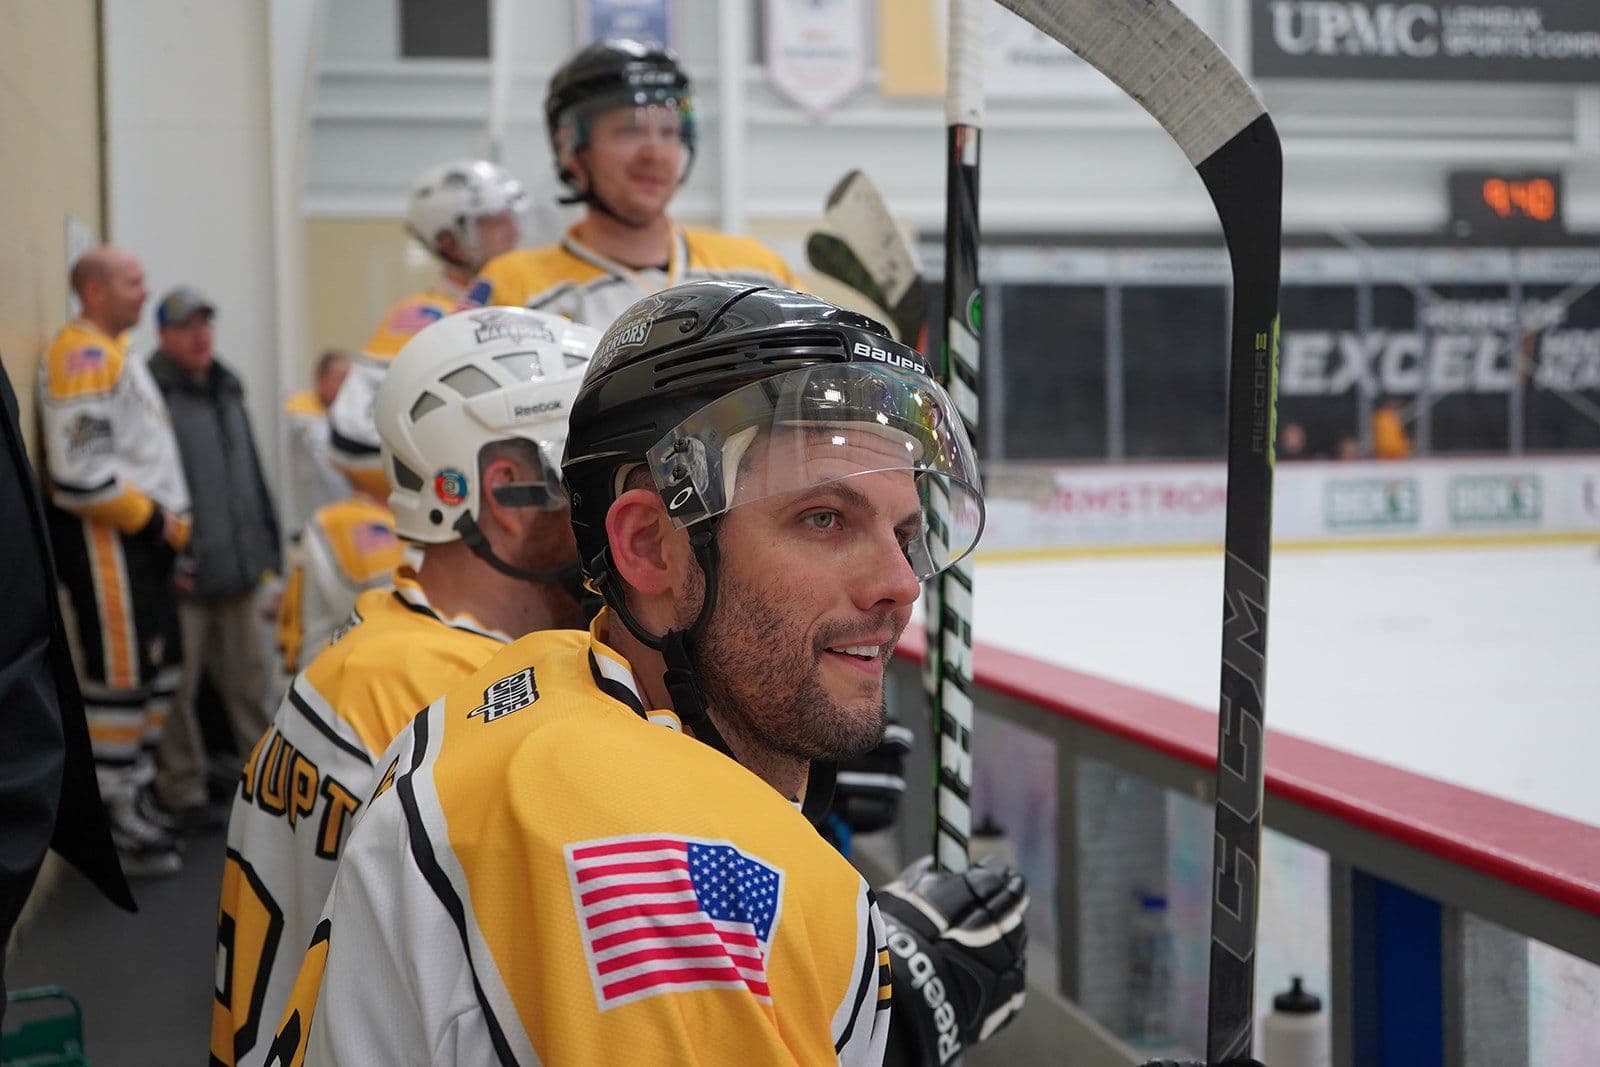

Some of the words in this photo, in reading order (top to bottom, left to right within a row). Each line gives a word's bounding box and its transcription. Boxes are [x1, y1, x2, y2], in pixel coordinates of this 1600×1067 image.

[1271, 4, 1438, 57] UPMC
[853, 342, 925, 375] BAUER
[1279, 331, 1516, 396] EXCEL
[514, 400, 562, 417] Reebok
[1211, 552, 1267, 963] CCM
